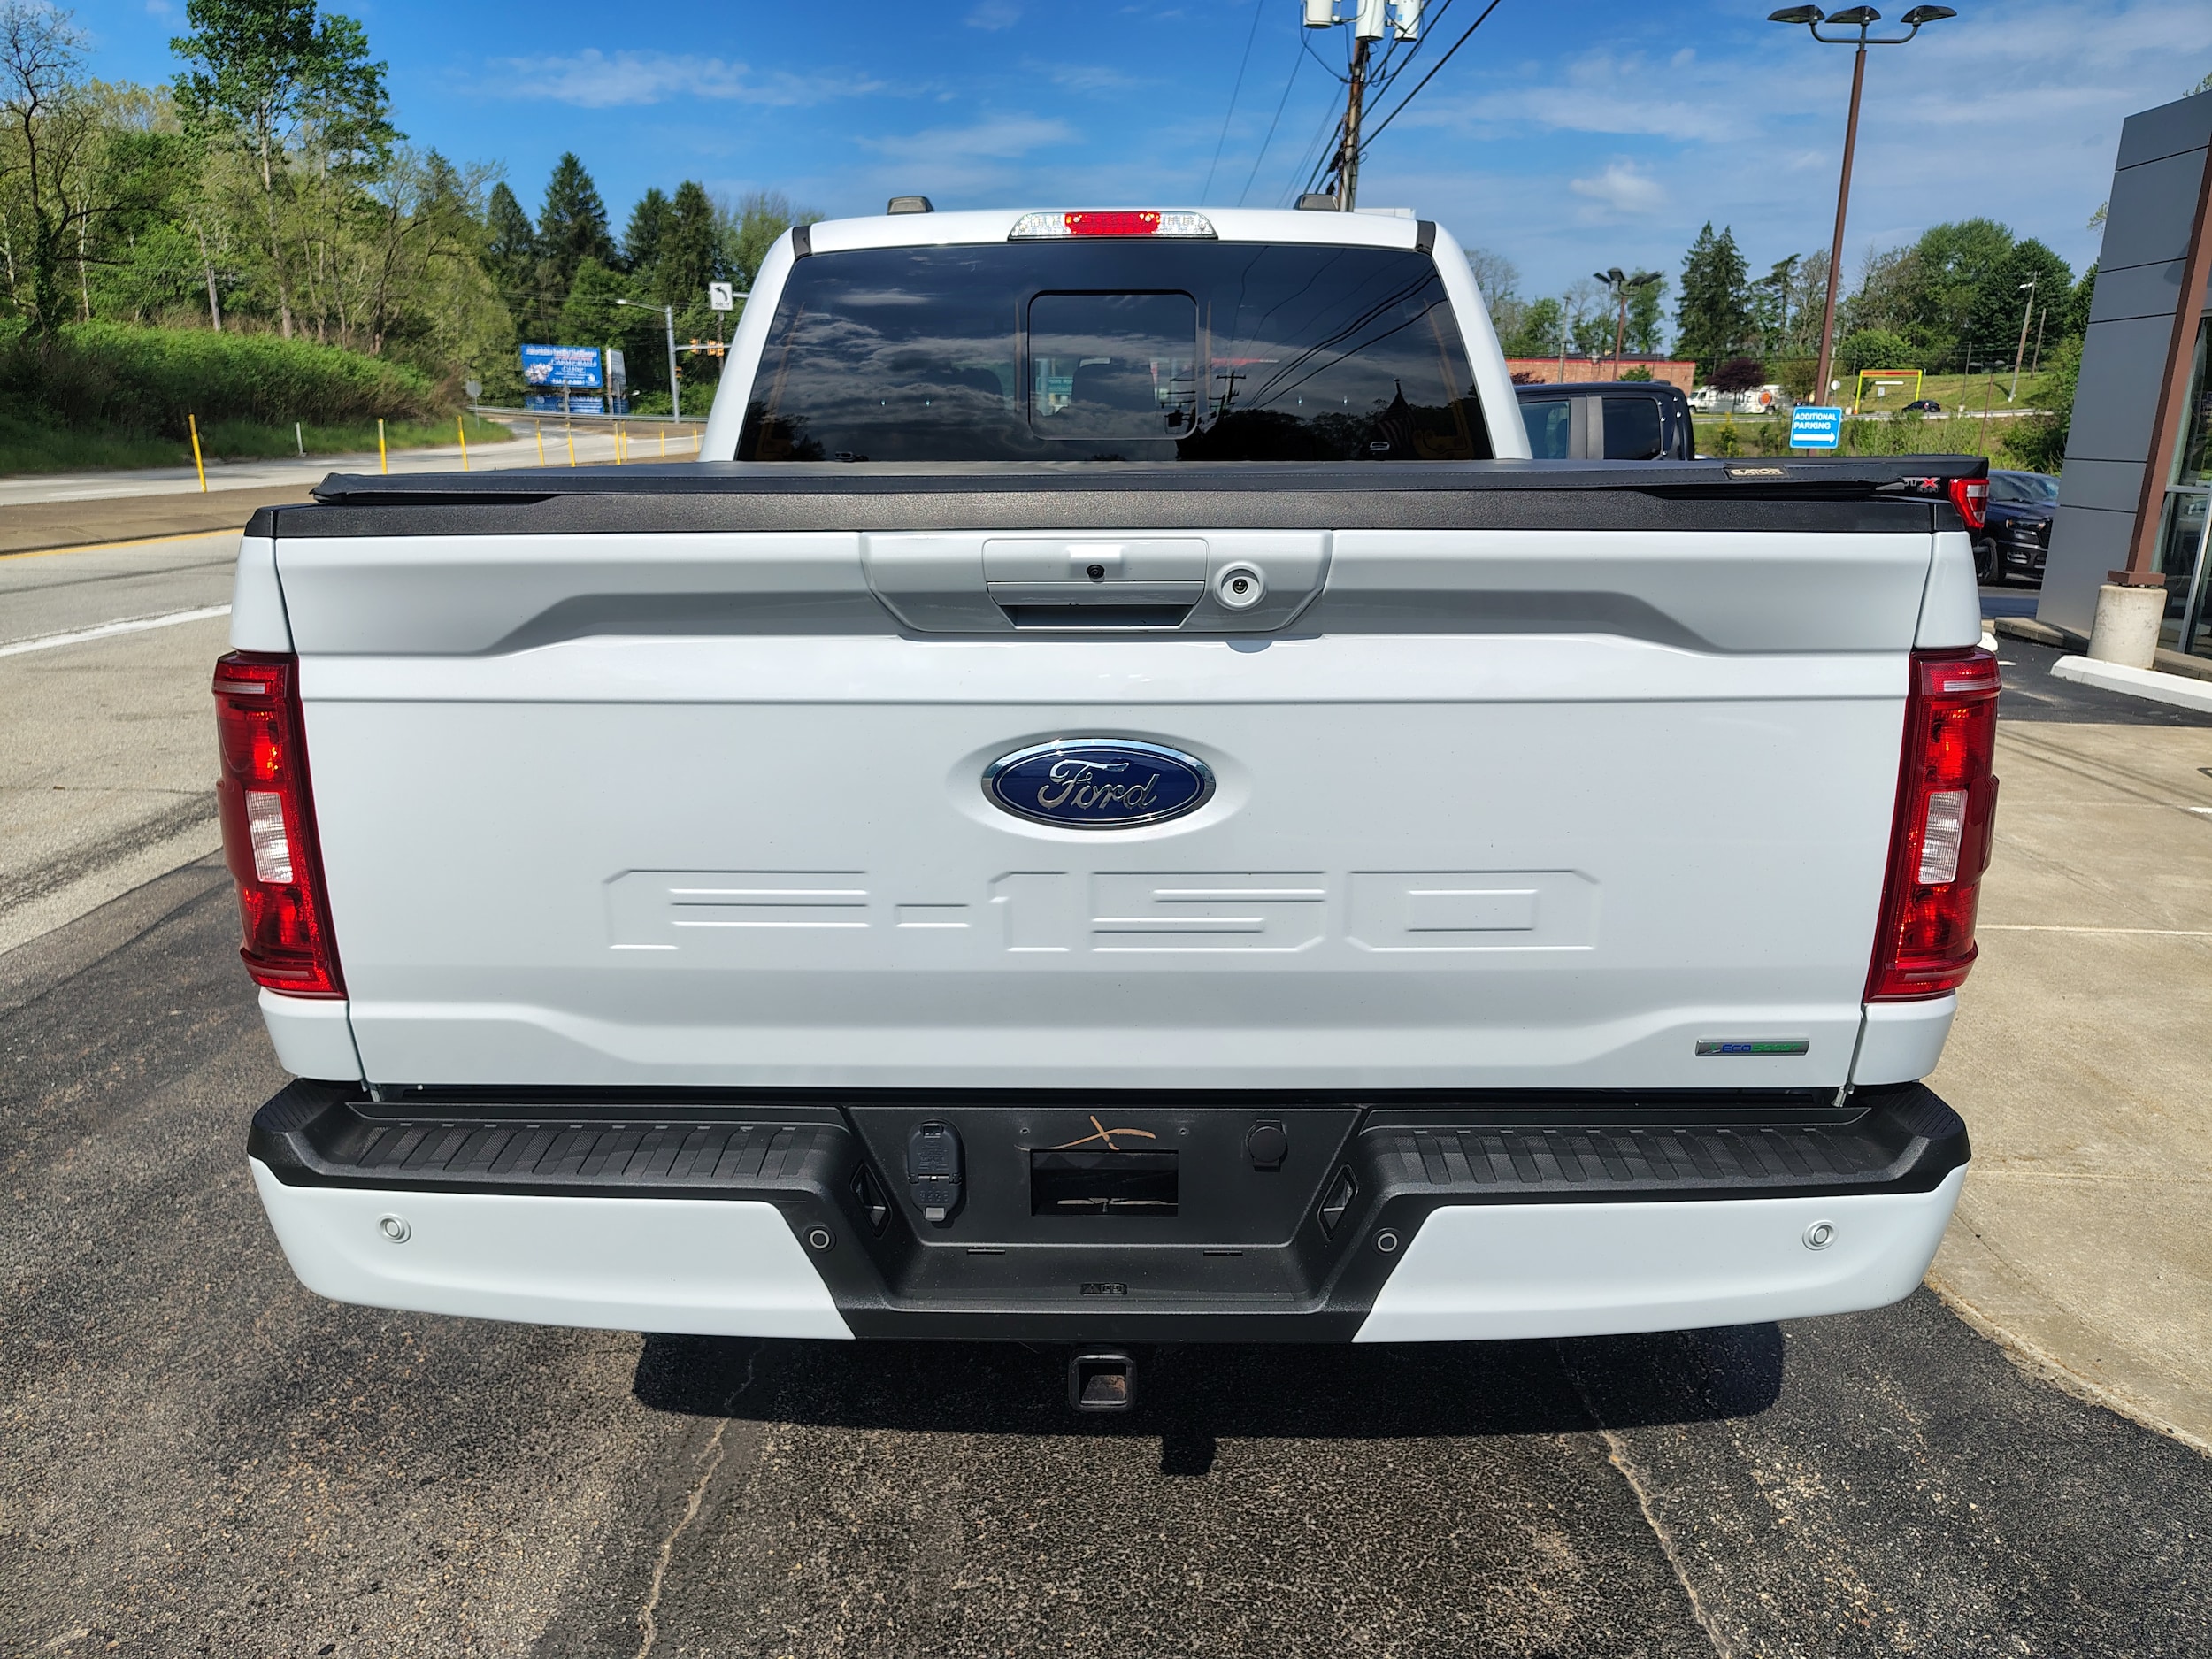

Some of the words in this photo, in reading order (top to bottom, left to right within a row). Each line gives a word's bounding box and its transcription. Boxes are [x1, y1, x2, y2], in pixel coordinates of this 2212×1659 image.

[1793, 421, 1832, 430] PARKING
[1794, 412, 1837, 421] ADDITIONAL
[1036, 758, 1160, 810] Ford
[603, 869, 1601, 953] F-150
